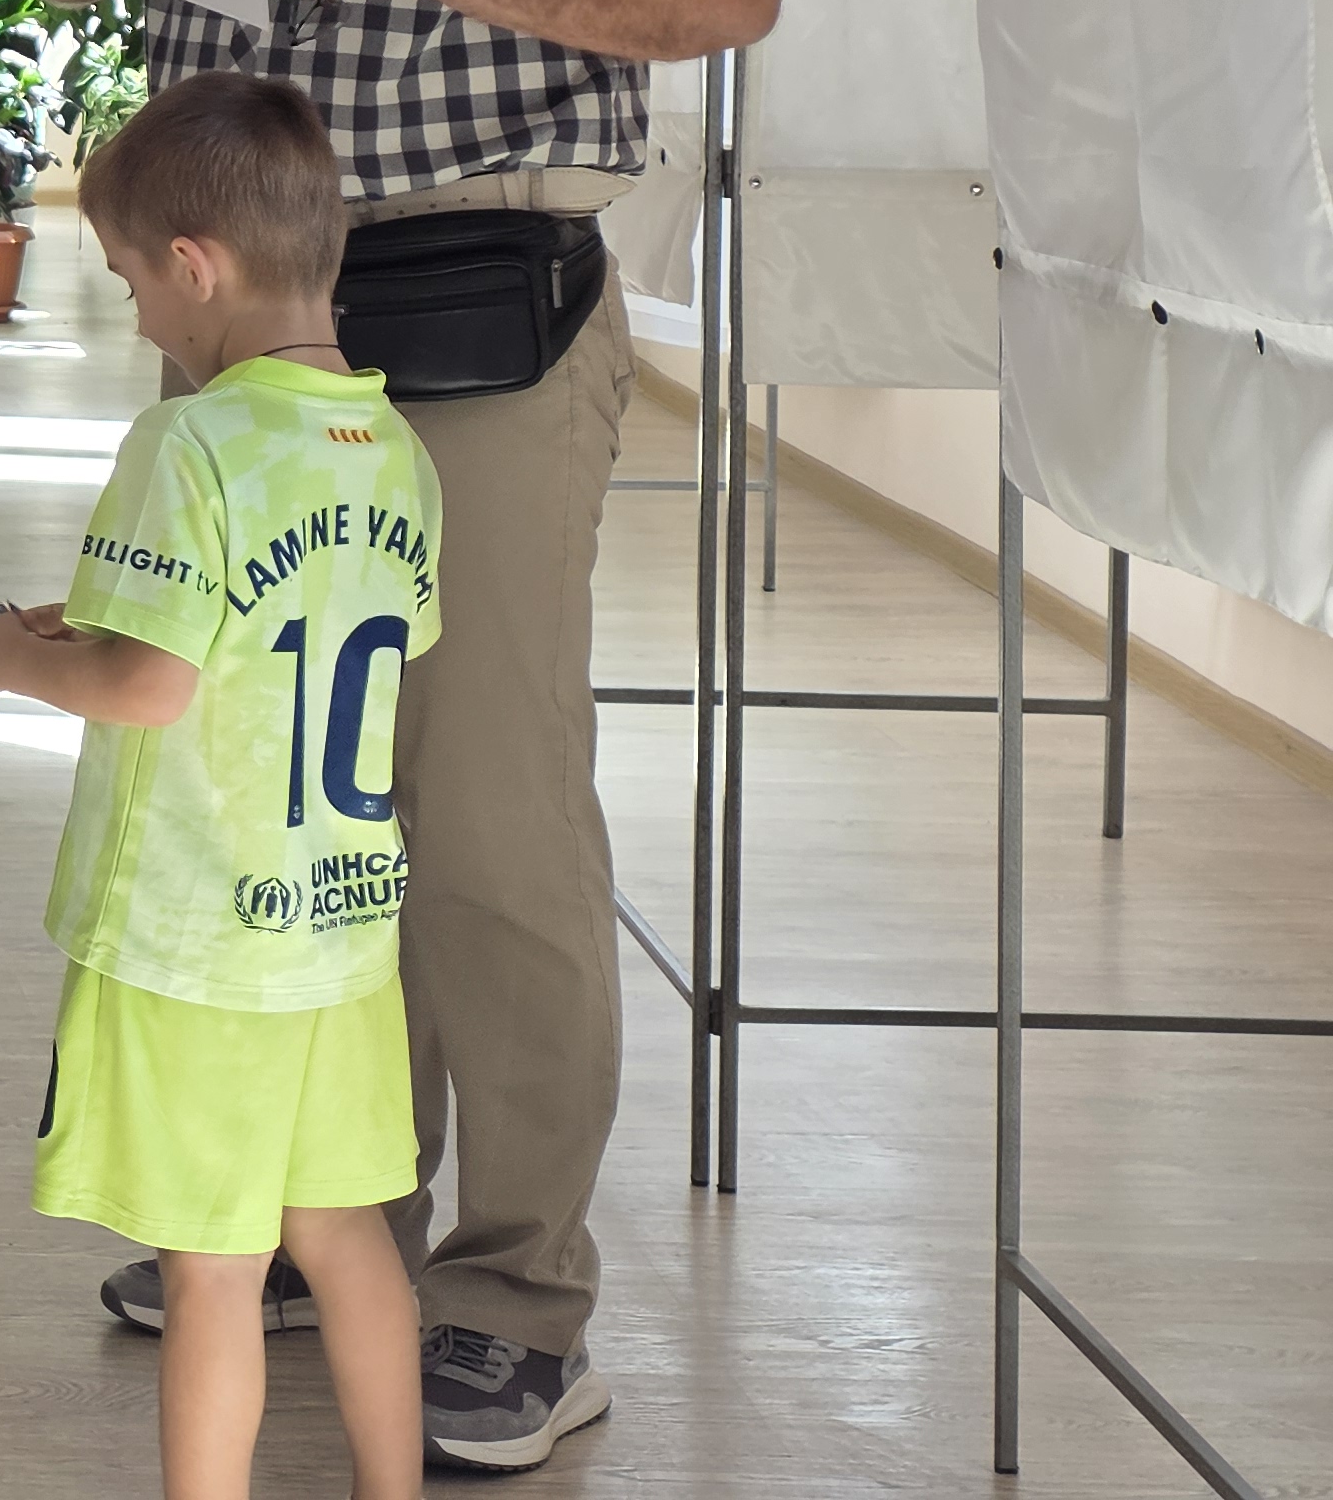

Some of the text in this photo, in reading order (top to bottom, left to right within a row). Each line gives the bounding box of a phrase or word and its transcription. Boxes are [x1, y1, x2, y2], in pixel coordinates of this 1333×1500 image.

[82, 534, 219, 595] BILIGHT tv
[226, 503, 350, 617] LAMINE
[270, 615, 410, 828] 10
[326, 917, 338, 931] UN
